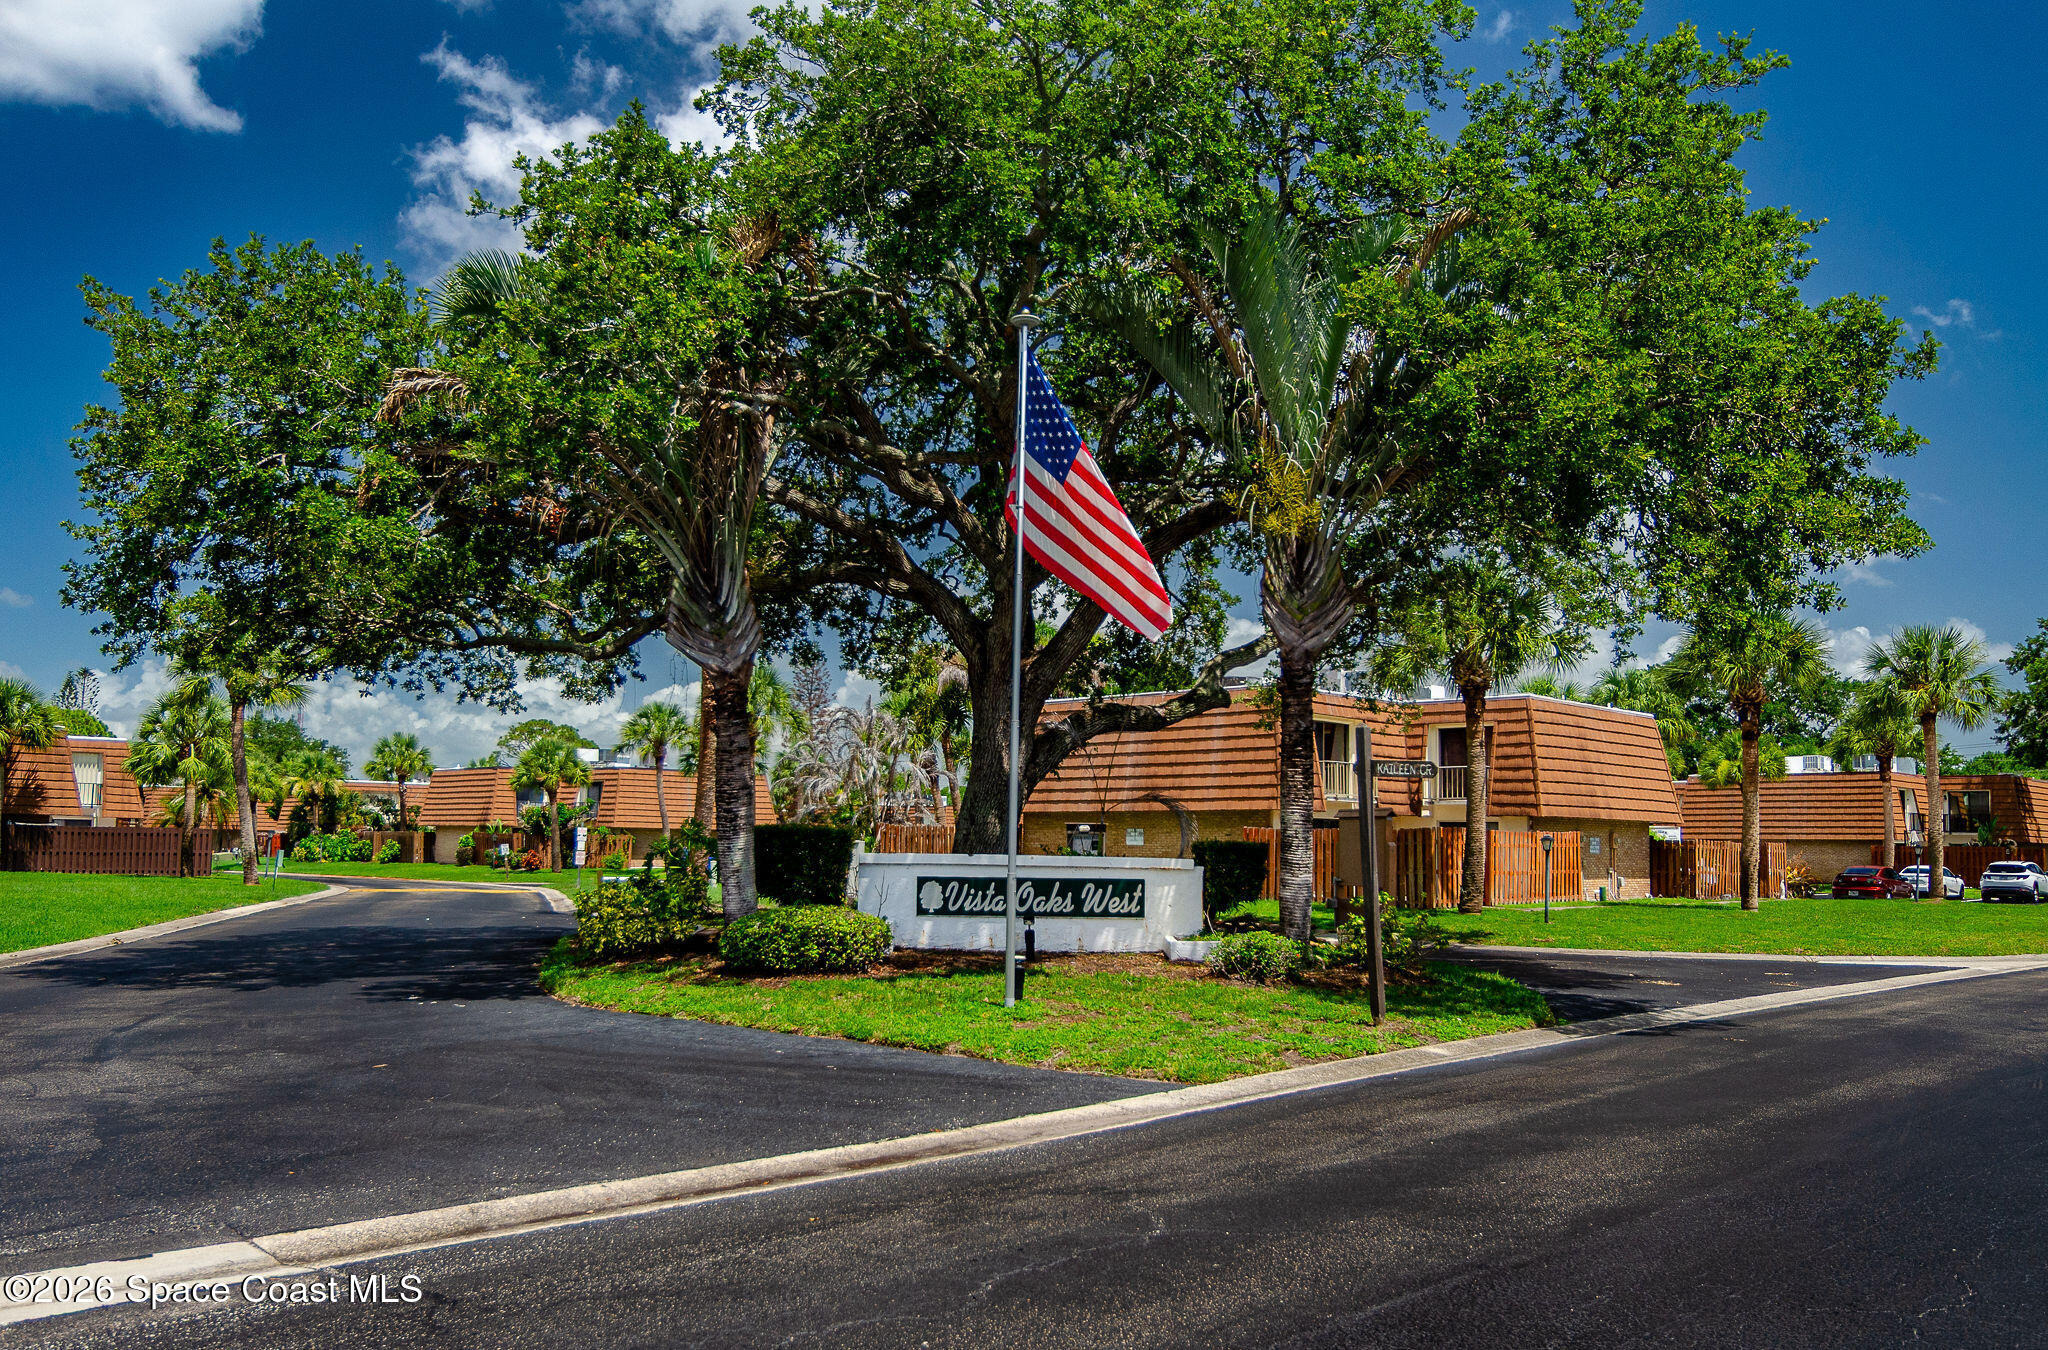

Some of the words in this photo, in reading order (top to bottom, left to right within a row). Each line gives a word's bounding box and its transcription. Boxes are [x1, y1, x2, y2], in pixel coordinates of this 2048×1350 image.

[945, 881, 1007, 912] Vista
[1015, 881, 1074, 912] Oaks
[1081, 883, 1142, 913] West
